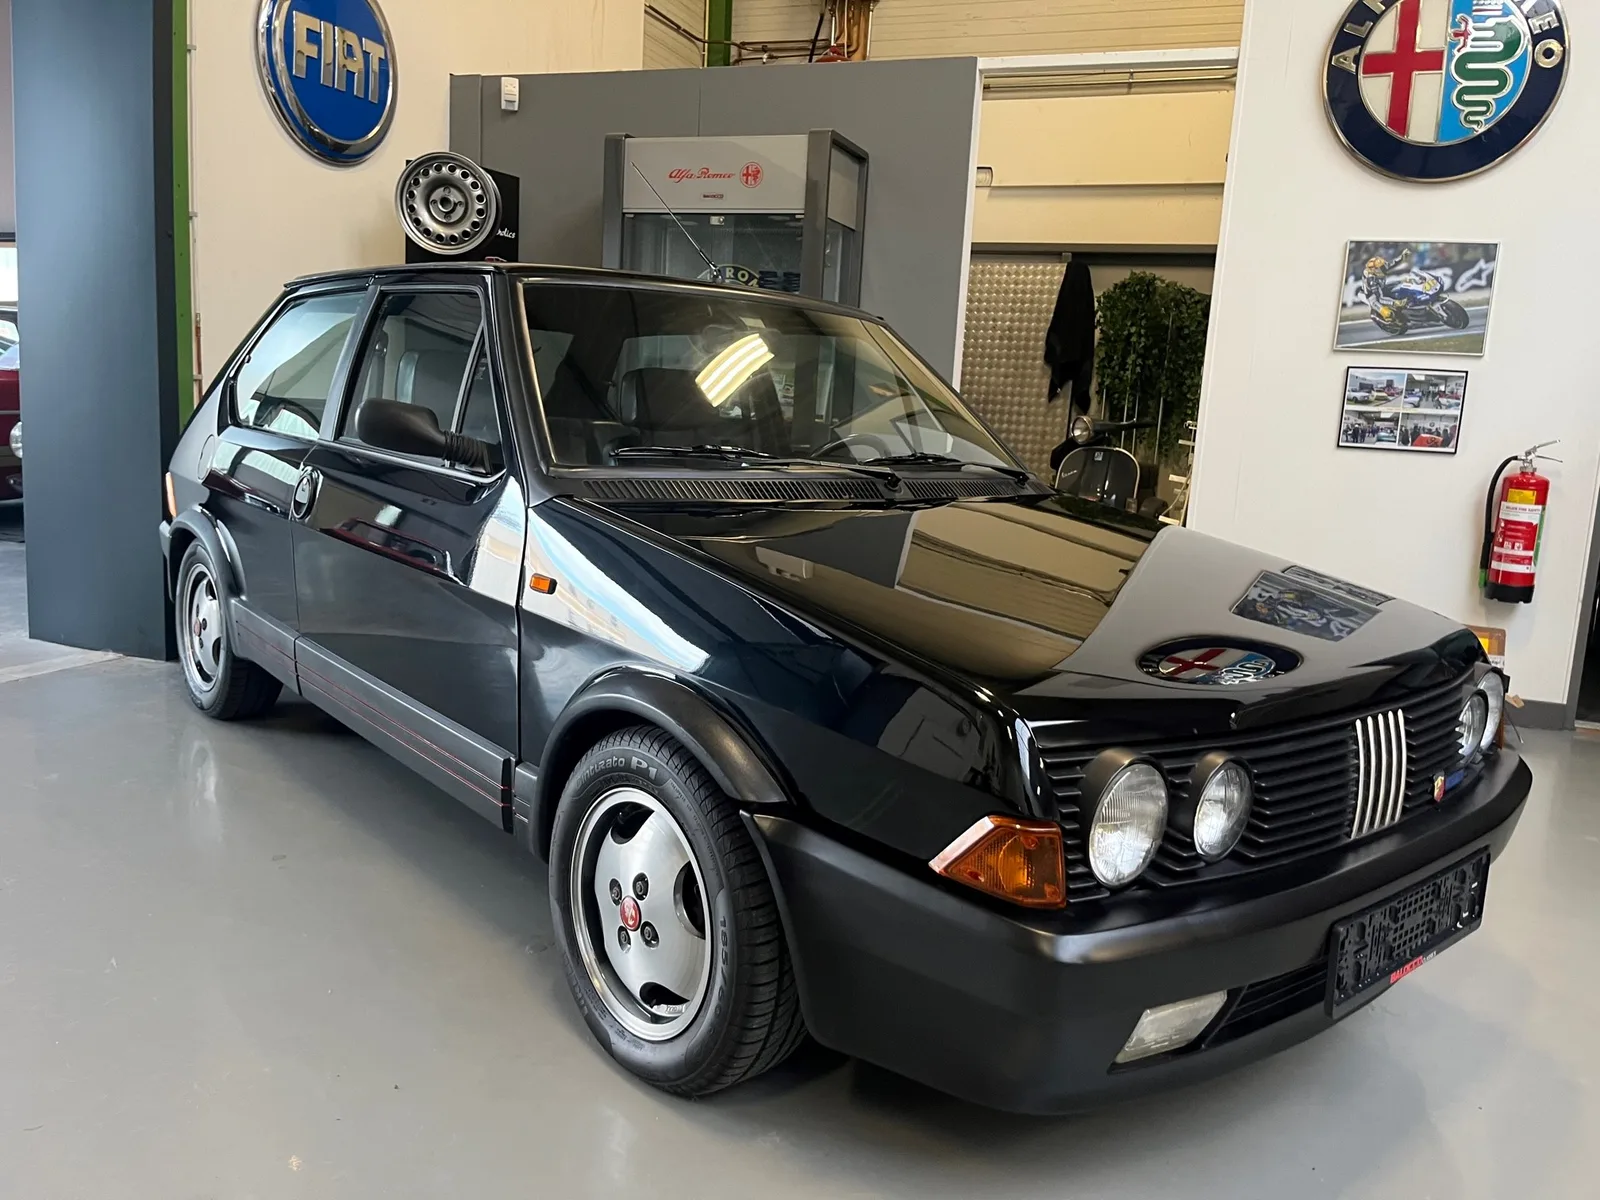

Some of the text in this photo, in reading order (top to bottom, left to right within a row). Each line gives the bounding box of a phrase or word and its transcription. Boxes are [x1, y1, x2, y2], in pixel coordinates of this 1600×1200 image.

[292, 10, 386, 104] FIAT
[668, 167, 736, 184] Alfa Romeo
[630, 756, 658, 781] P1
